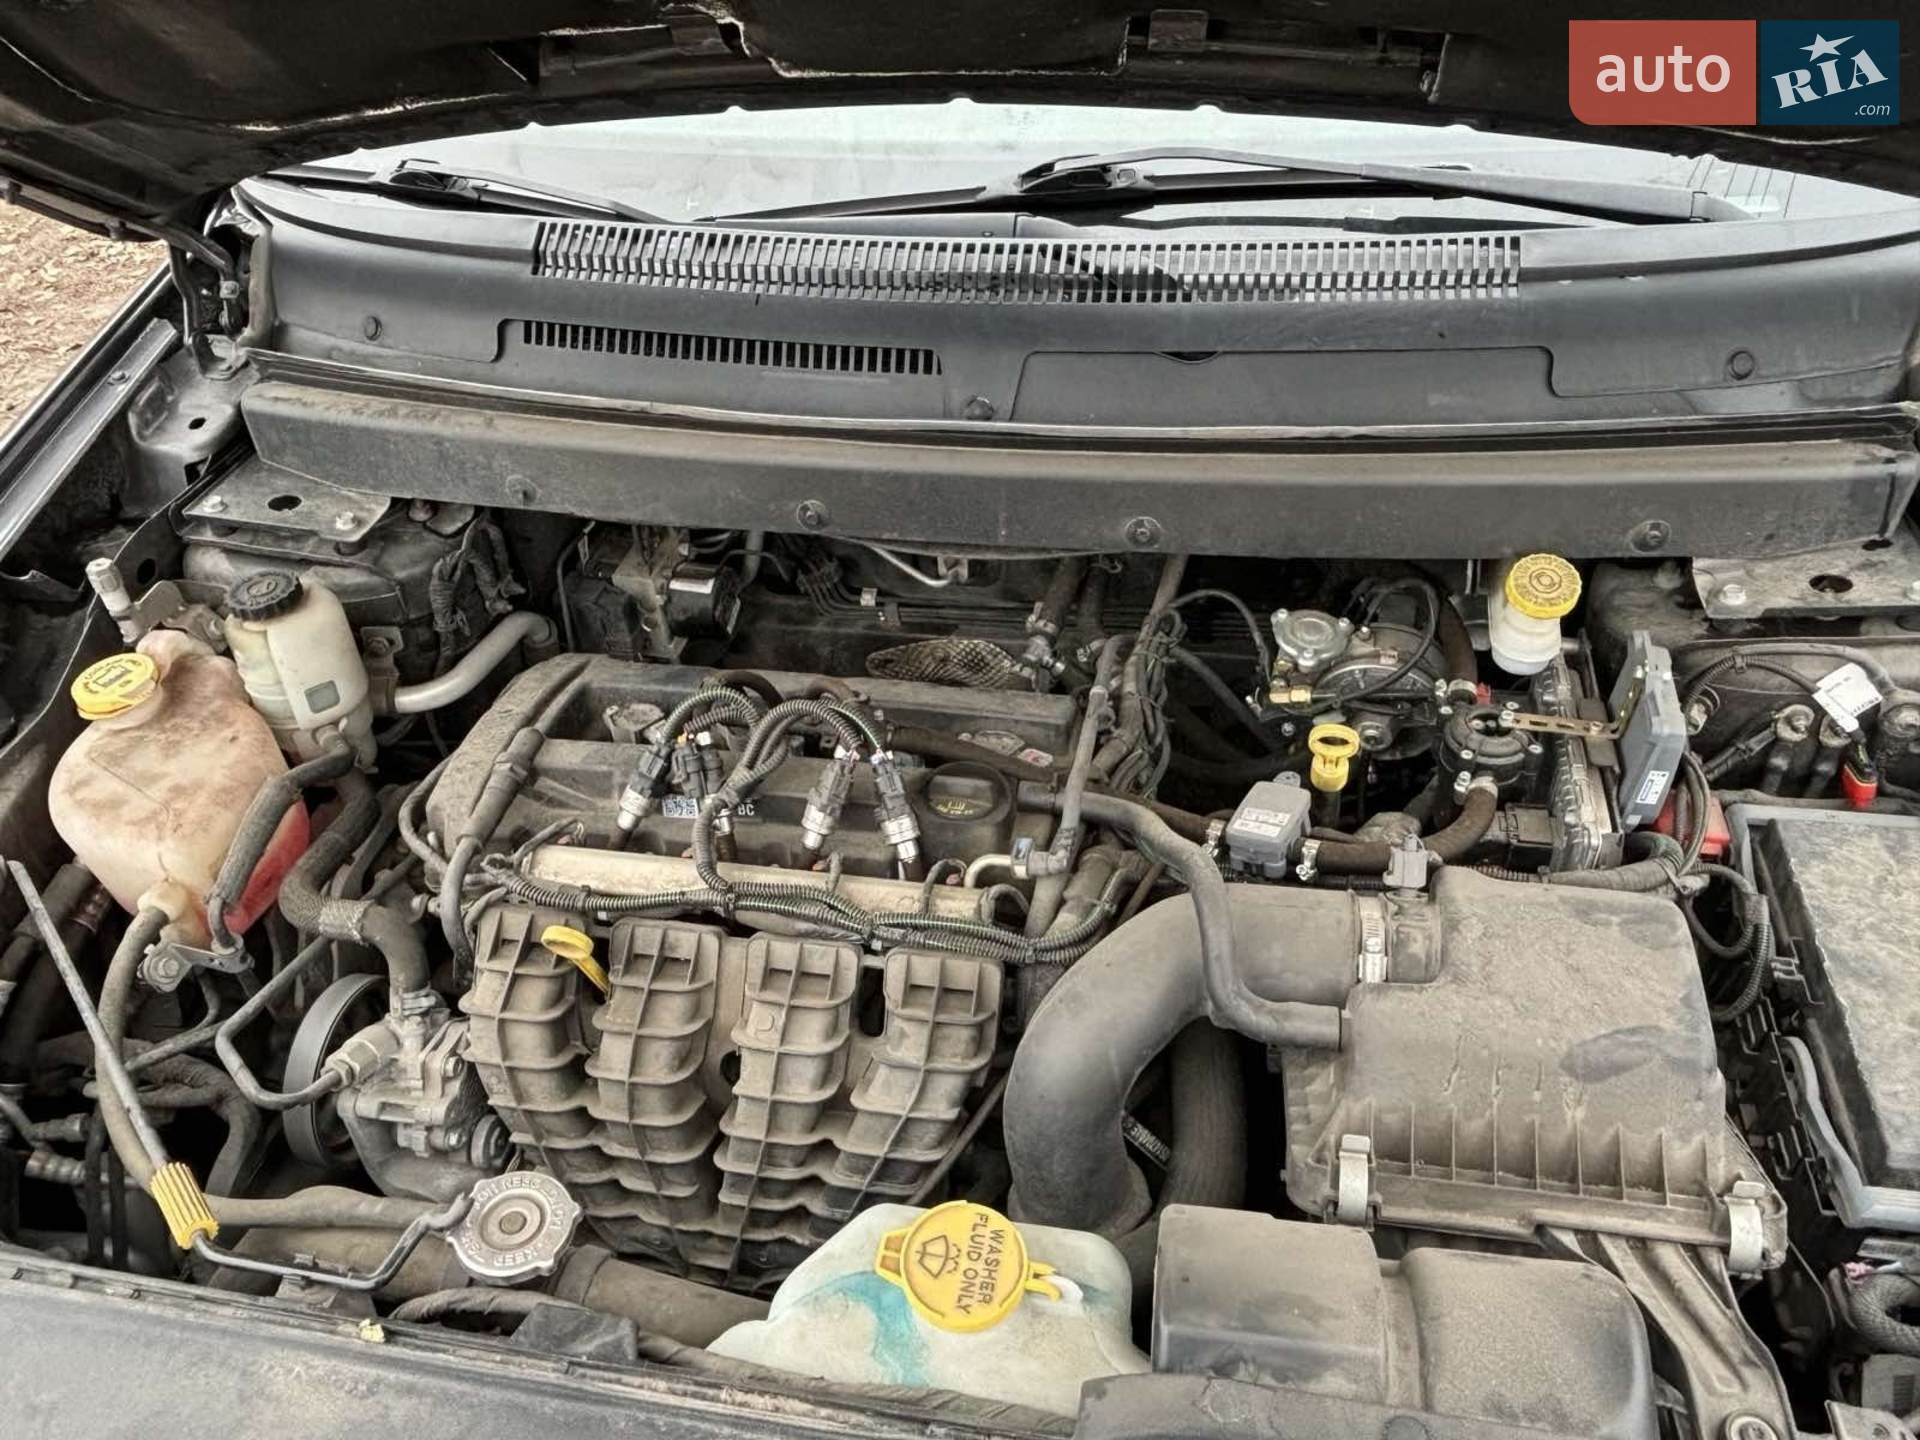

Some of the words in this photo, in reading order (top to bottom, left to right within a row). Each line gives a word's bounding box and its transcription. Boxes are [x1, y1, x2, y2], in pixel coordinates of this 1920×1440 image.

[492, 1246, 539, 1267] KEEP
[965, 1211, 990, 1262] FLUID
[955, 1267, 979, 1316] ONLY
[978, 1228, 1006, 1305] WASHER
